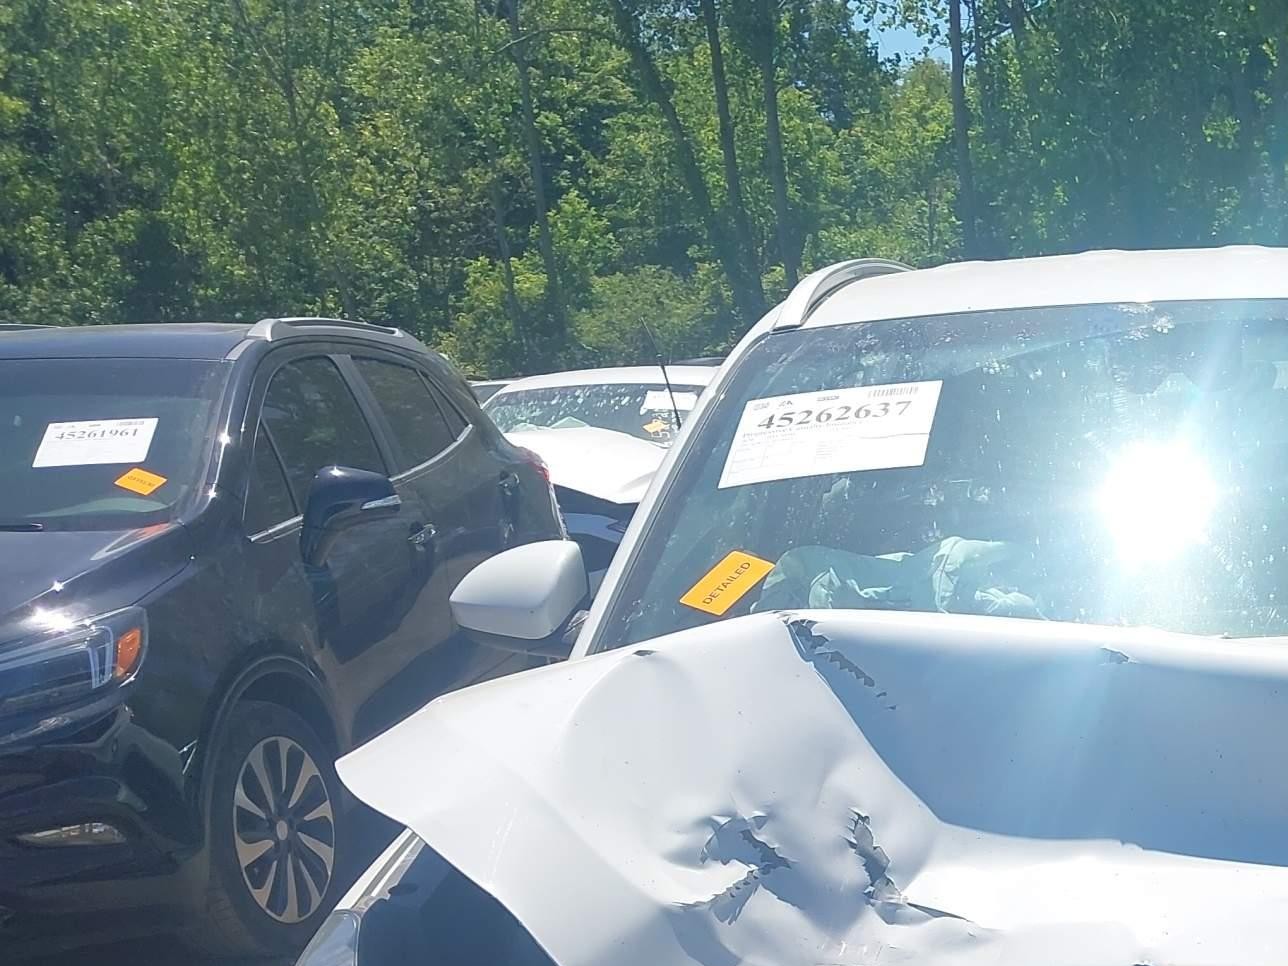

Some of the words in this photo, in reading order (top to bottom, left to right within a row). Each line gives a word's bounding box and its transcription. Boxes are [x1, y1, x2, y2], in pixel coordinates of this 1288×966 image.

[757, 400, 912, 430] 45262637
[56, 428, 138, 440] 45261961
[702, 562, 751, 605] DETAILED
